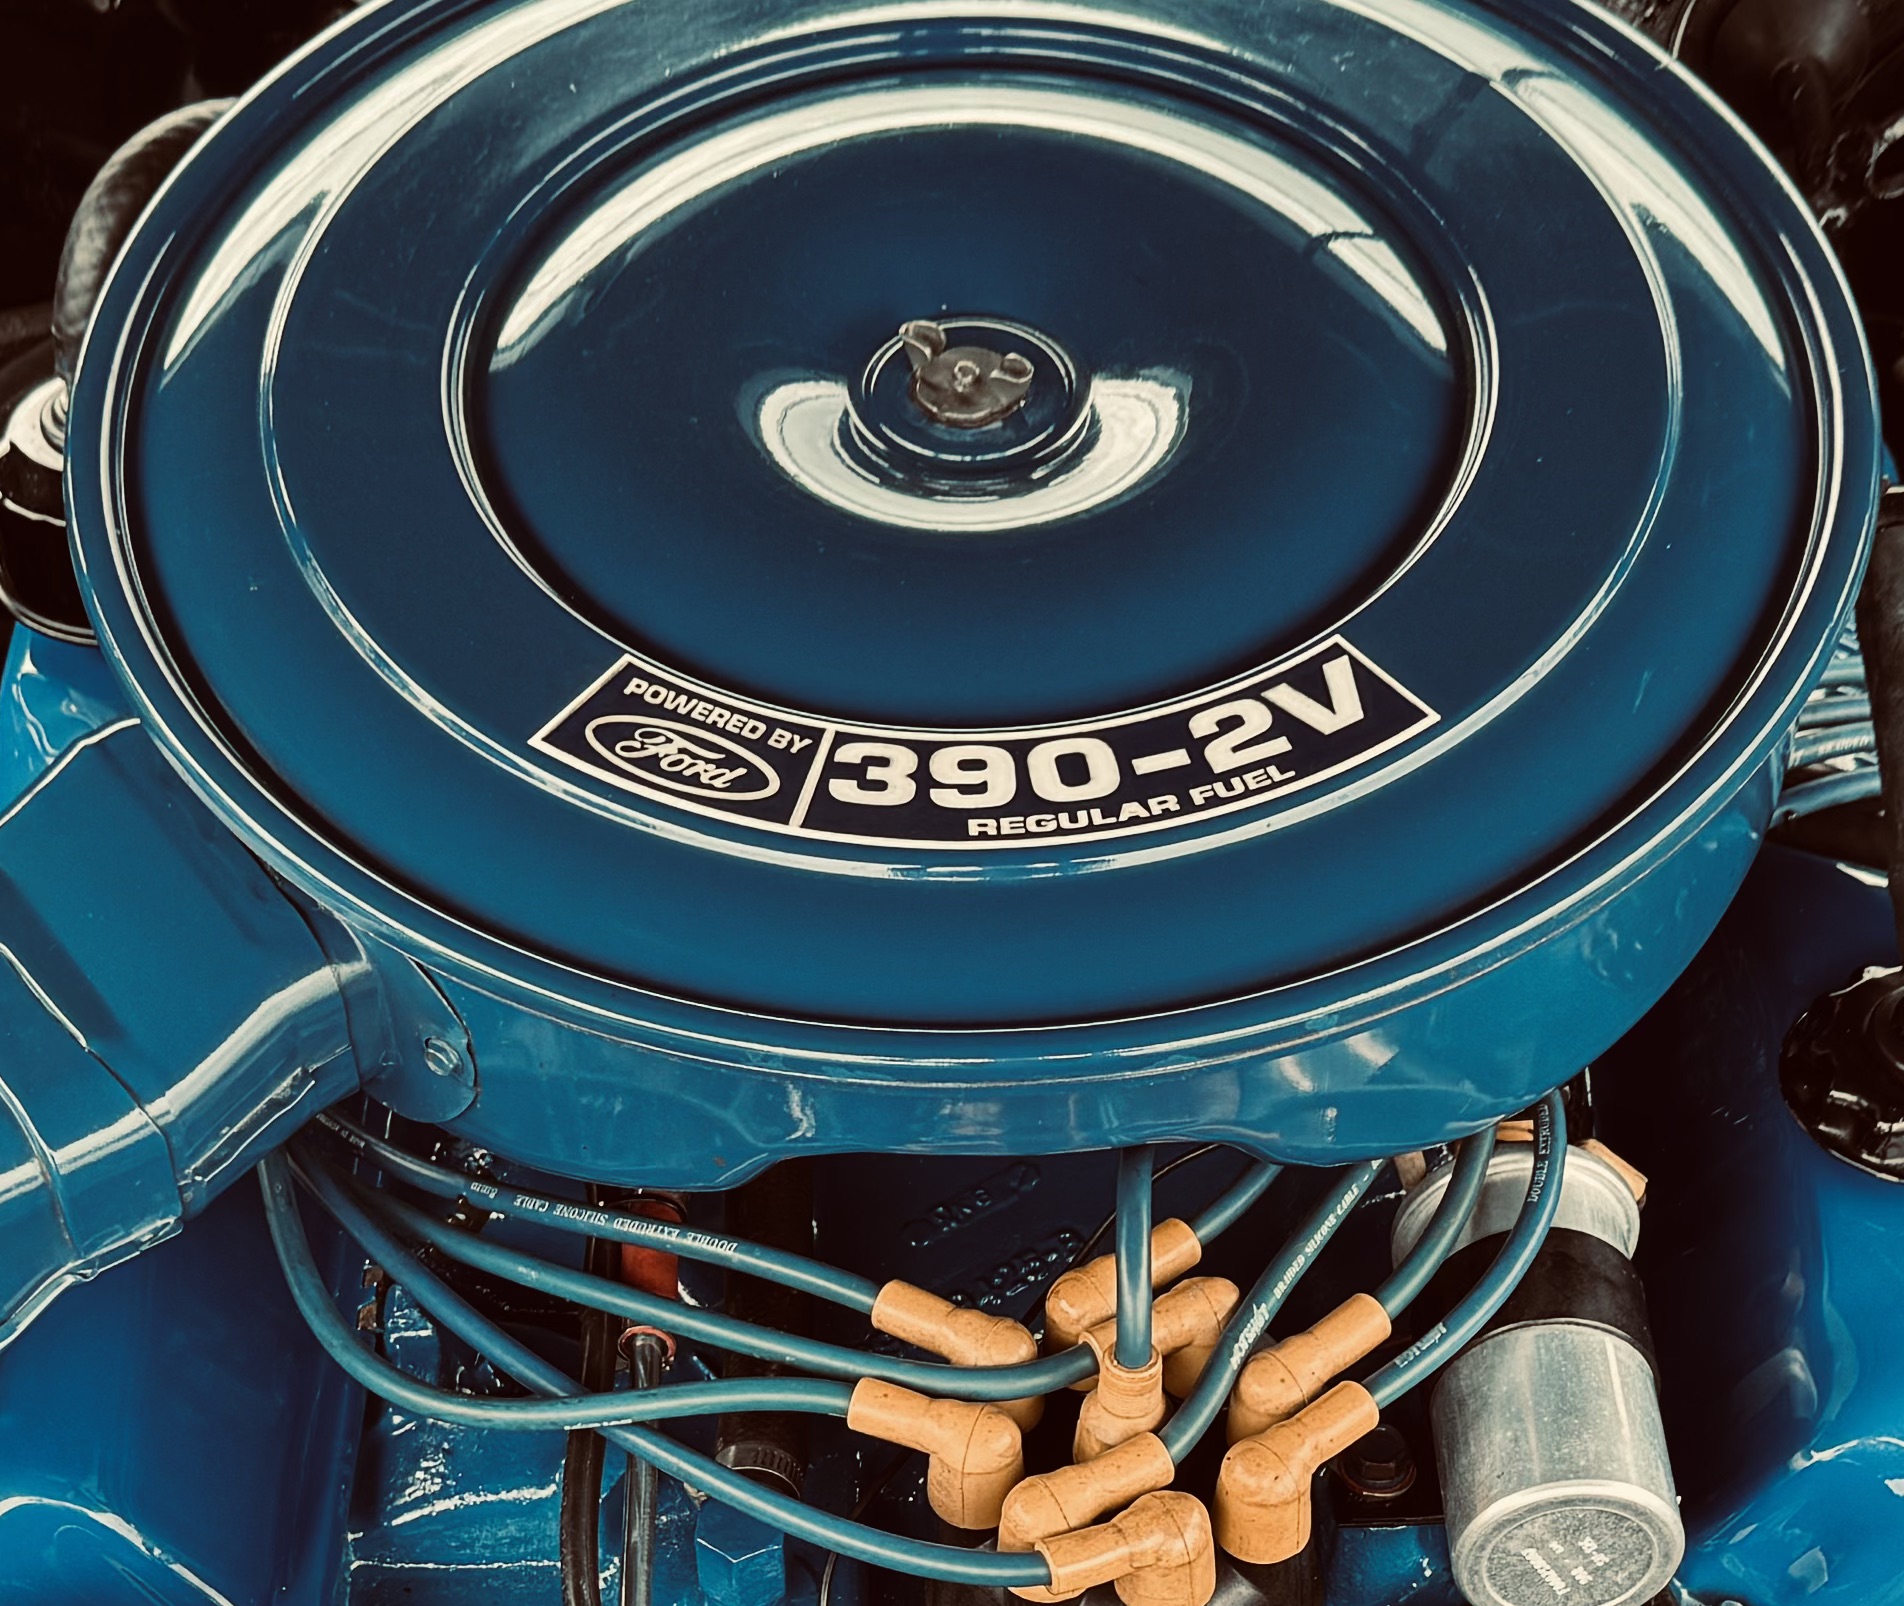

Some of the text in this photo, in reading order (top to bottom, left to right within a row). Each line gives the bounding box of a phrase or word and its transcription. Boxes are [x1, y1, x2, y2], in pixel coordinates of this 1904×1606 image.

[622, 676, 813, 755] POWERED BY
[827, 655, 1366, 809] 390-2V
[615, 725, 734, 790] Ford
[966, 765, 1298, 838] REGULAR FUEL
[514, 1194, 550, 1213] CABLE
[1527, 1160, 1549, 1203] DOUBLE
[553, 1203, 609, 1225] SILICONE
[613, 1217, 681, 1241] EXTRUDED
[686, 1231, 738, 1254] DOUBLE
[1273, 1254, 1306, 1299] BRAIDED
[1304, 1213, 1337, 1256] SILICONE
